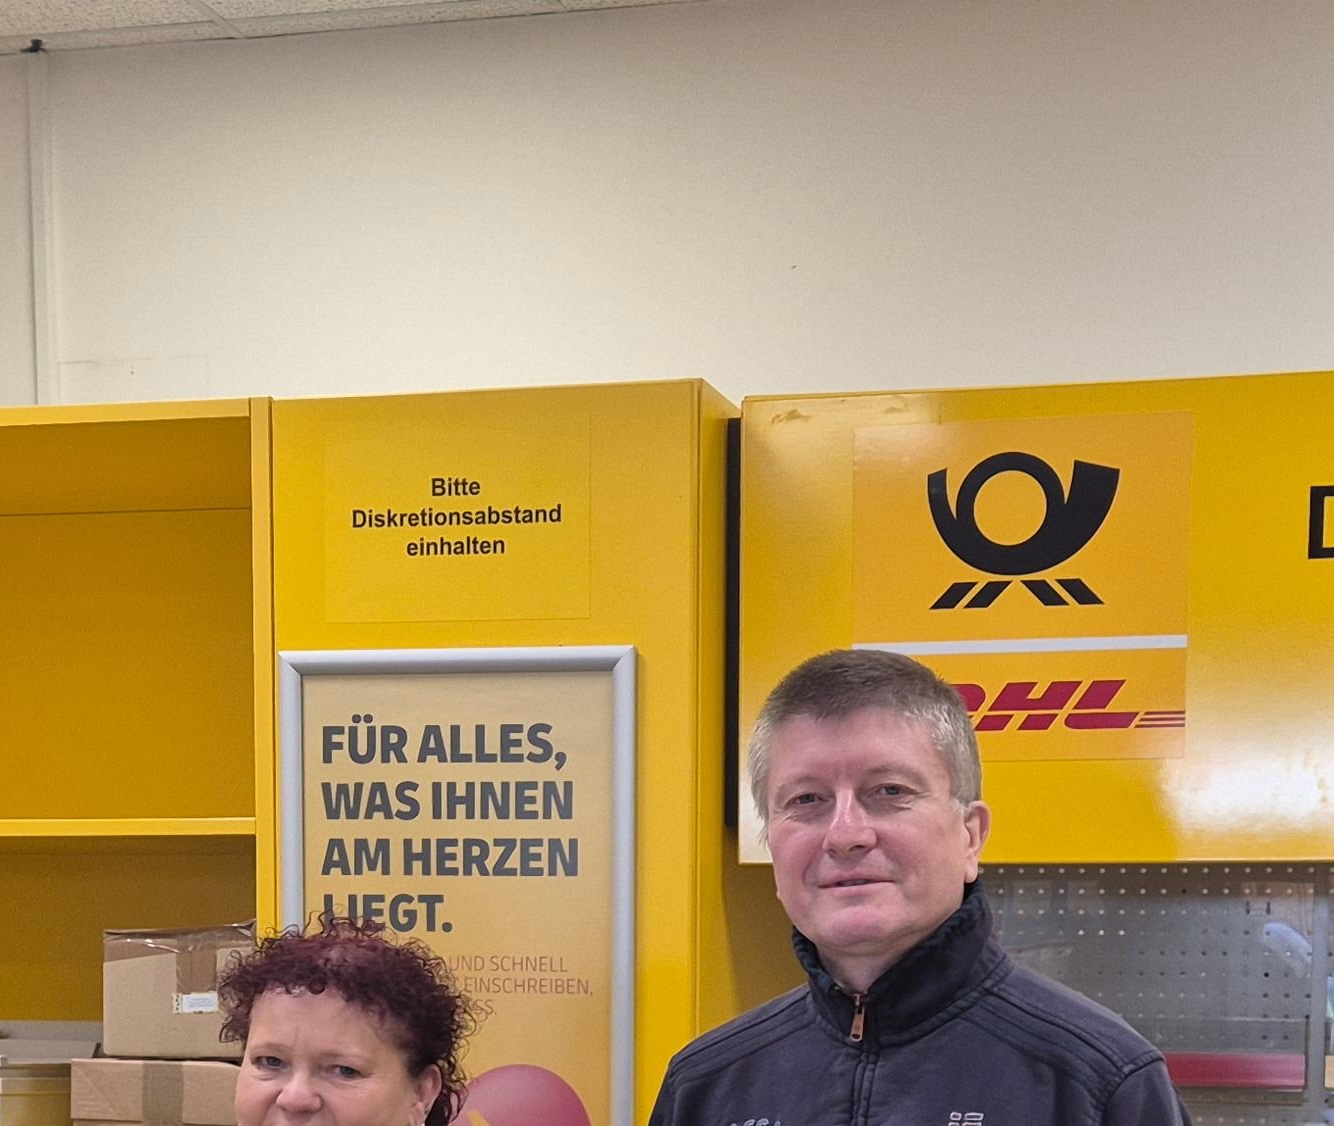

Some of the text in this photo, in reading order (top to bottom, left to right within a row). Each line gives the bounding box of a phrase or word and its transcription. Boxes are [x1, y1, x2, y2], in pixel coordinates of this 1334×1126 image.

[431, 477, 481, 497] Bitte
[352, 503, 562, 528] Diskretionsabstand
[406, 535, 505, 556] einhalten
[322, 713, 567, 771] FÜR ALLES,
[321, 780, 574, 821] WAS IHNEN
[321, 837, 579, 877] AM HERZEN
[323, 893, 453, 933] LIEGT.
[490, 955, 570, 973] SCHNELL
[464, 976, 594, 996] EINSCHREIBEN,
